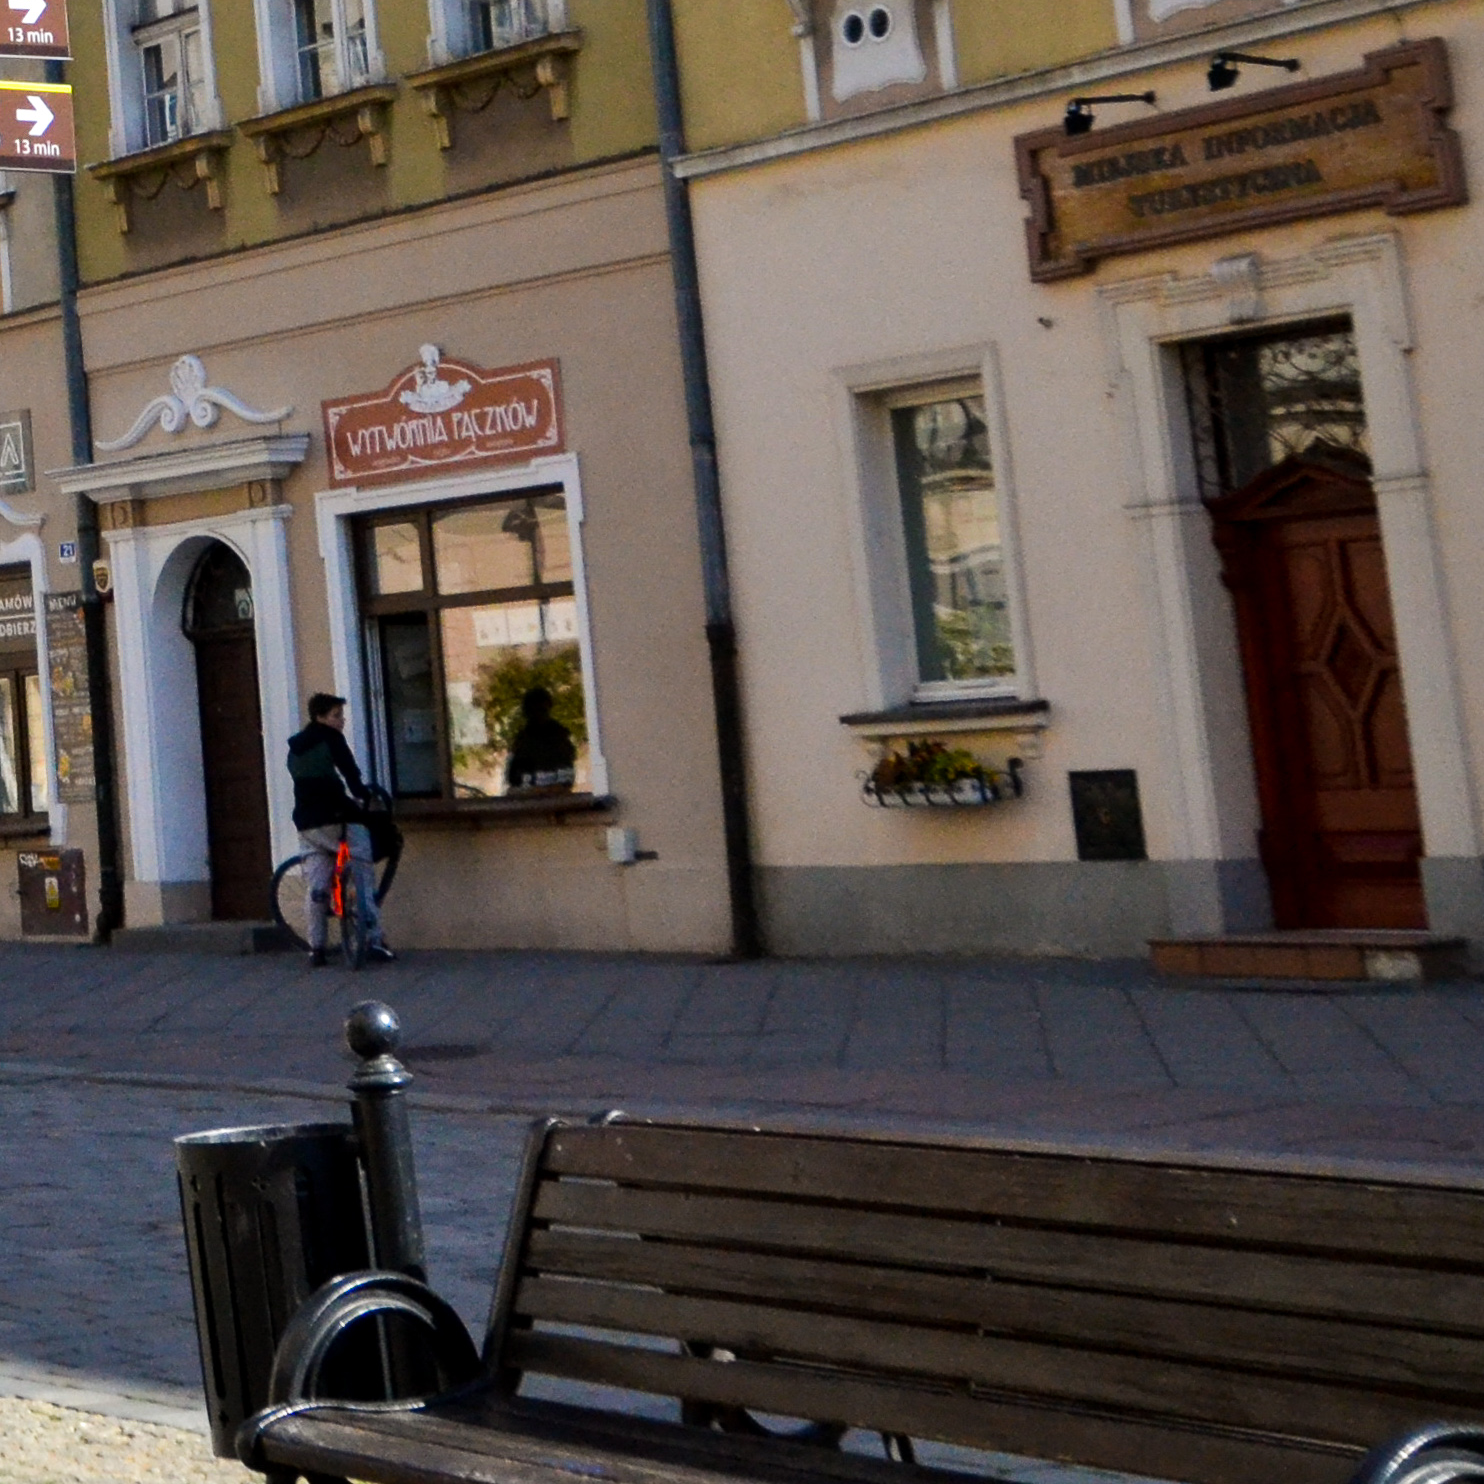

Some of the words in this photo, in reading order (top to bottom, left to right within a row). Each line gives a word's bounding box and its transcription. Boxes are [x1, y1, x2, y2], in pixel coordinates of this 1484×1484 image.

[7, 27, 24, 43] 13
[27, 28, 54, 44] min
[14, 139, 31, 155] 13
[33, 139, 61, 157] min
[1071, 142, 1189, 188] MIEJSKA
[1201, 98, 1383, 161] INFORMACJA
[1129, 157, 1324, 217] TURYSTYCZNA
[346, 416, 448, 458] WYTWÓRNIA
[451, 395, 539, 442] PĄCZKÓW
[63, 544, 73, 556] 21
